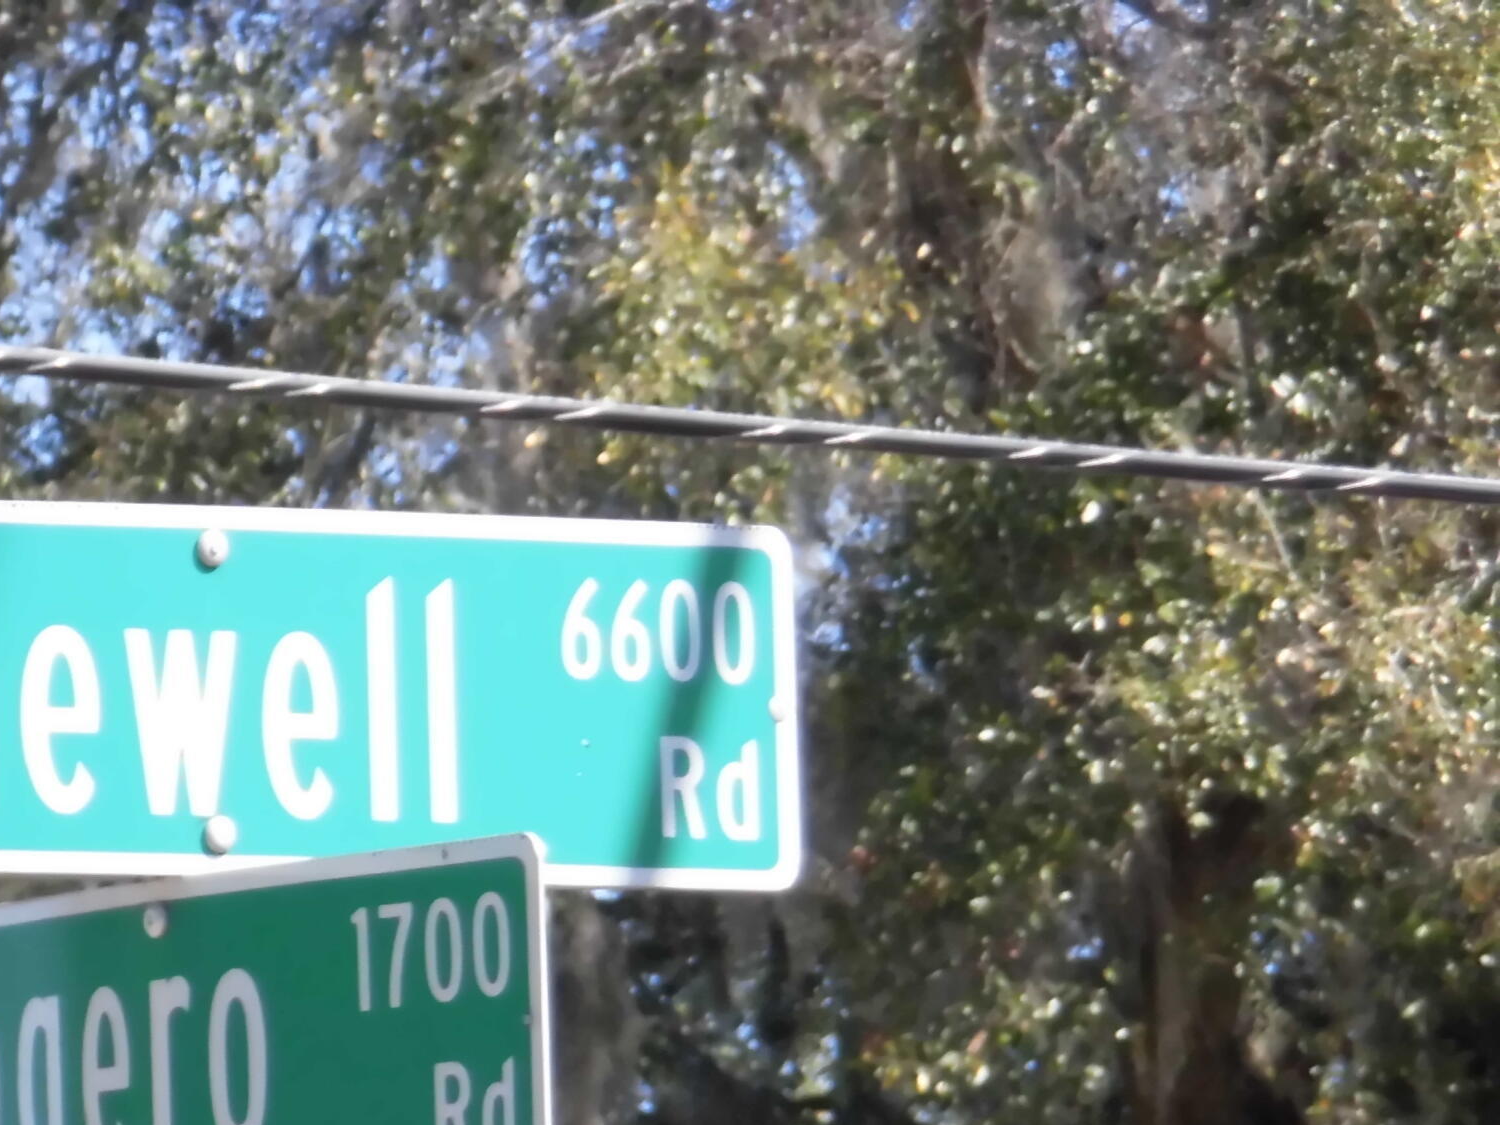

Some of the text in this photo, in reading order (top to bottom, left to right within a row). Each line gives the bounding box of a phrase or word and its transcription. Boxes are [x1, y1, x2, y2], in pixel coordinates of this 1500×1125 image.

[560, 577, 756, 686] 6600
[659, 735, 760, 841] Rd
[350, 891, 511, 1012] 1700
